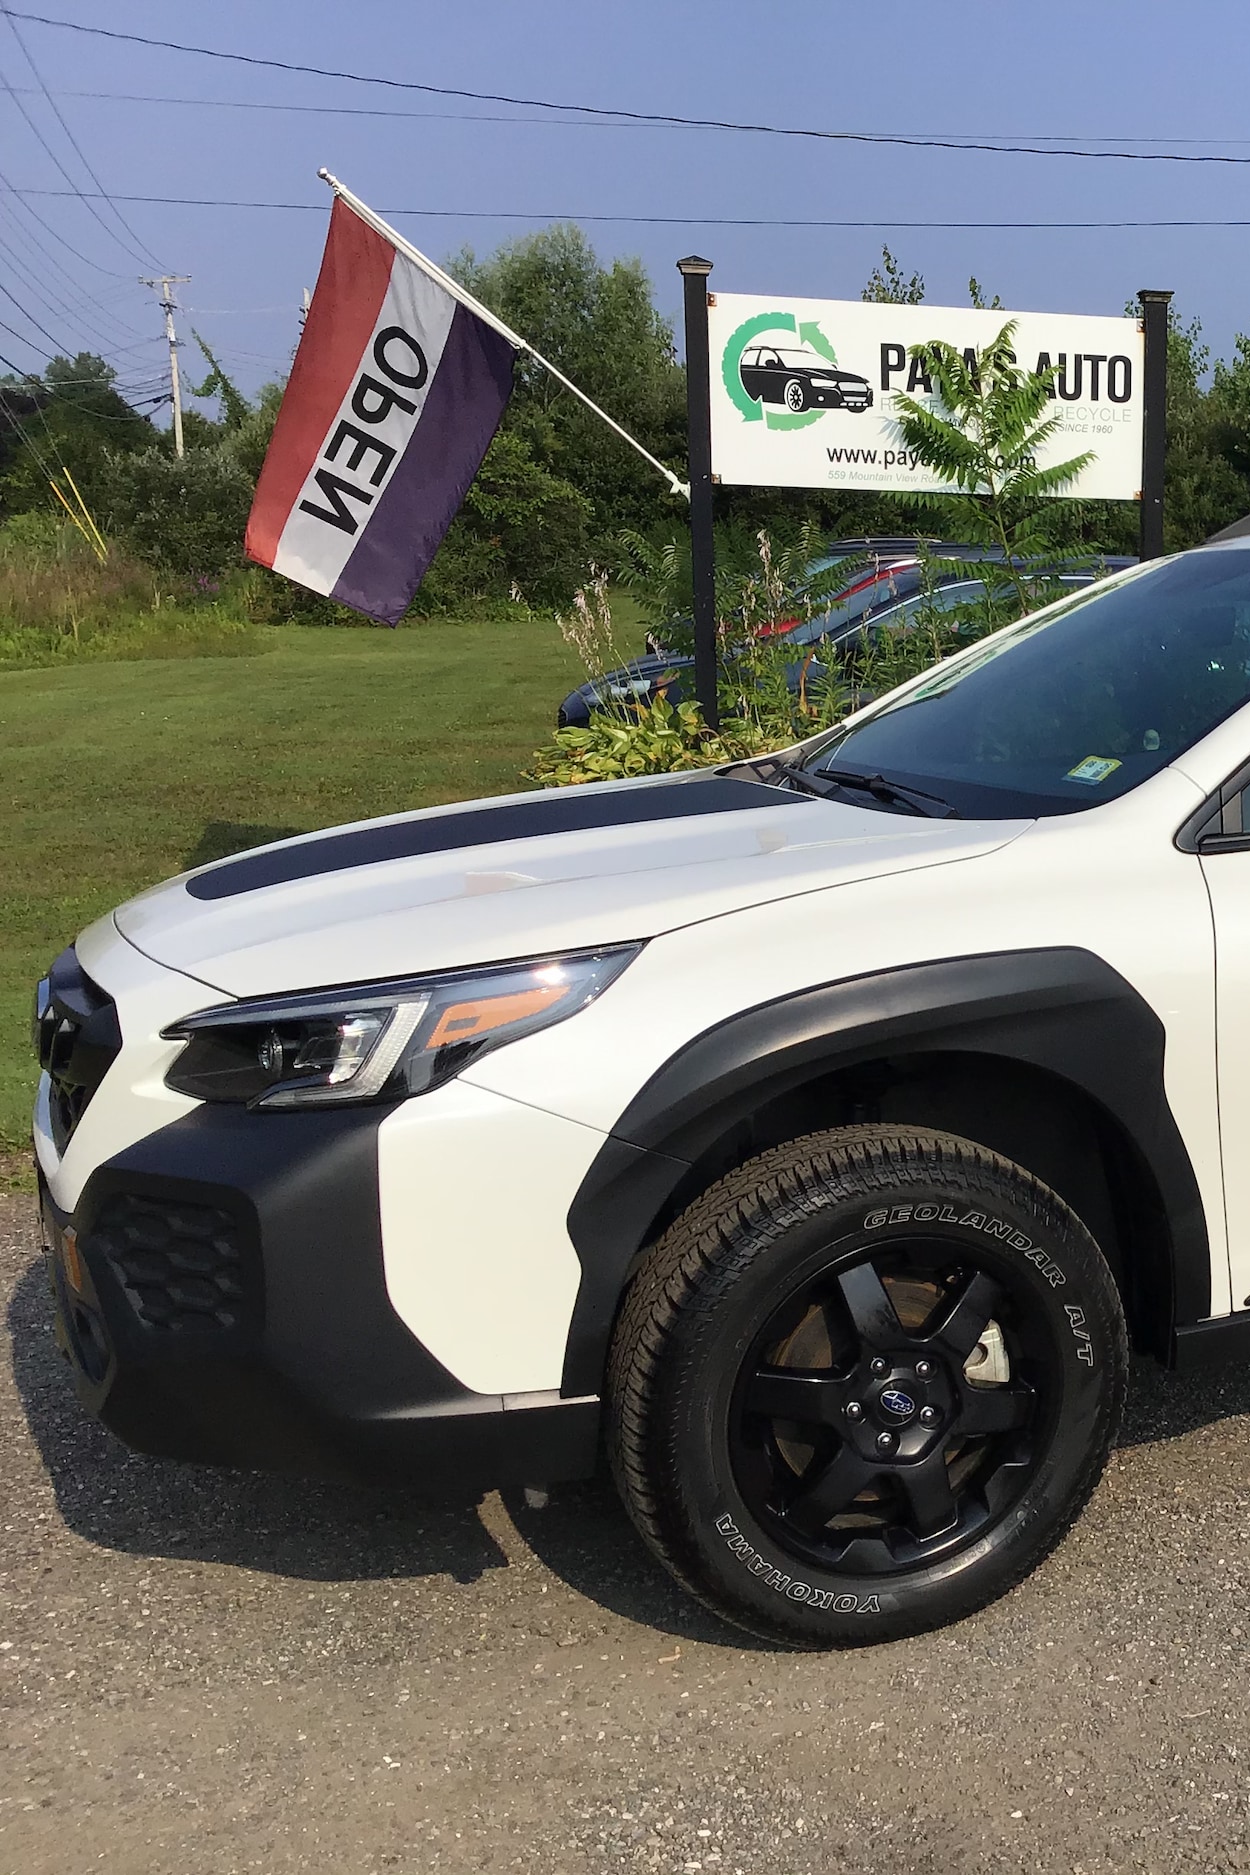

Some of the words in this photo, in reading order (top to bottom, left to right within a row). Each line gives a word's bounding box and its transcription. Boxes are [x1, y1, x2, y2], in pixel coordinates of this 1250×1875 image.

[1035, 352, 1132, 403] AUTO
[1053, 406, 1131, 423] RECYCLE
[1059, 423, 1088, 433] SINCE
[1091, 424, 1113, 434] 1960
[828, 470, 846, 480] 559
[848, 471, 892, 482] Mountain
[895, 473, 918, 483] View
[863, 1204, 1067, 1288] GEOLANDAR
[1064, 1303, 1095, 1367] A/T
[715, 1512, 881, 1614] YOKOHAMA
